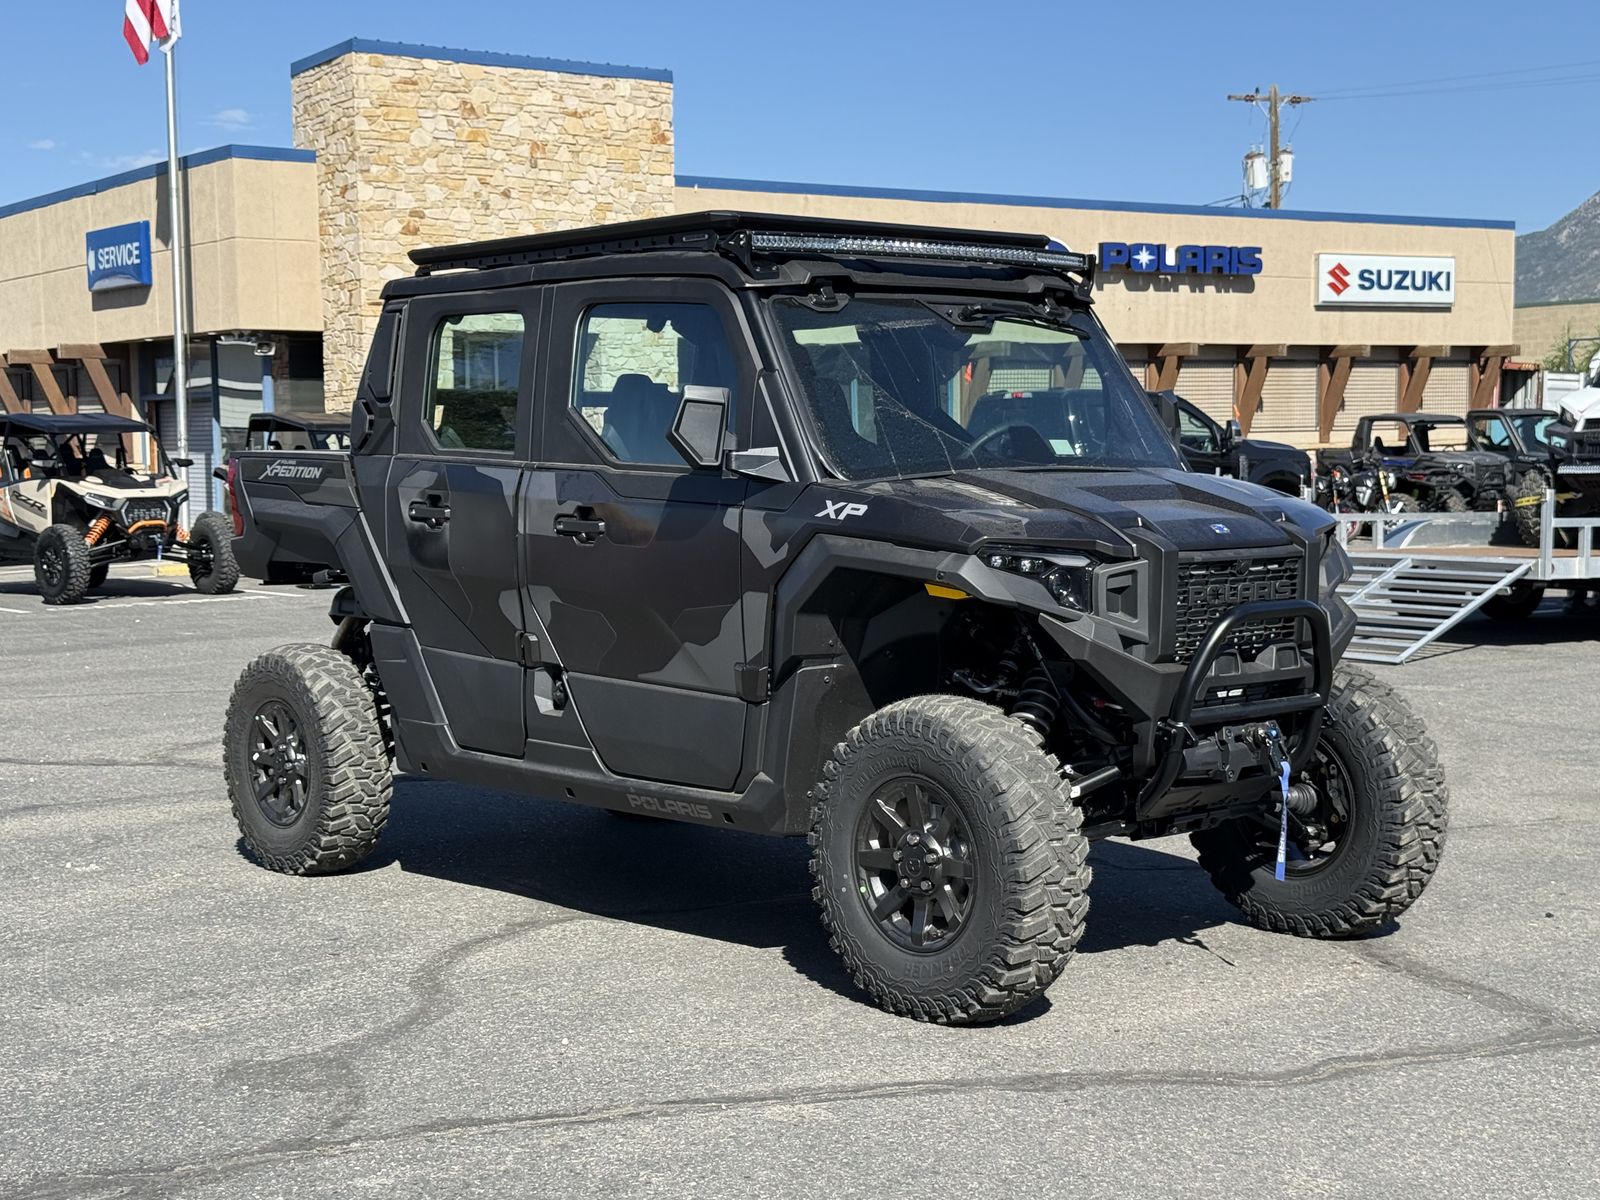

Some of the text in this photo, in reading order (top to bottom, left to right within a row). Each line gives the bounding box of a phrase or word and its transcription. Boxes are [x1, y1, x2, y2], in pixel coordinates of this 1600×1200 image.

[97, 242, 141, 270] SERVICE
[1099, 242, 1263, 275] POLARIS
[1358, 269, 1451, 291] SUZUKI
[258, 460, 323, 480] XPEDITION
[814, 500, 869, 520] XP
[1189, 580, 1292, 606] POLARIS
[626, 793, 713, 819] POLARIS
